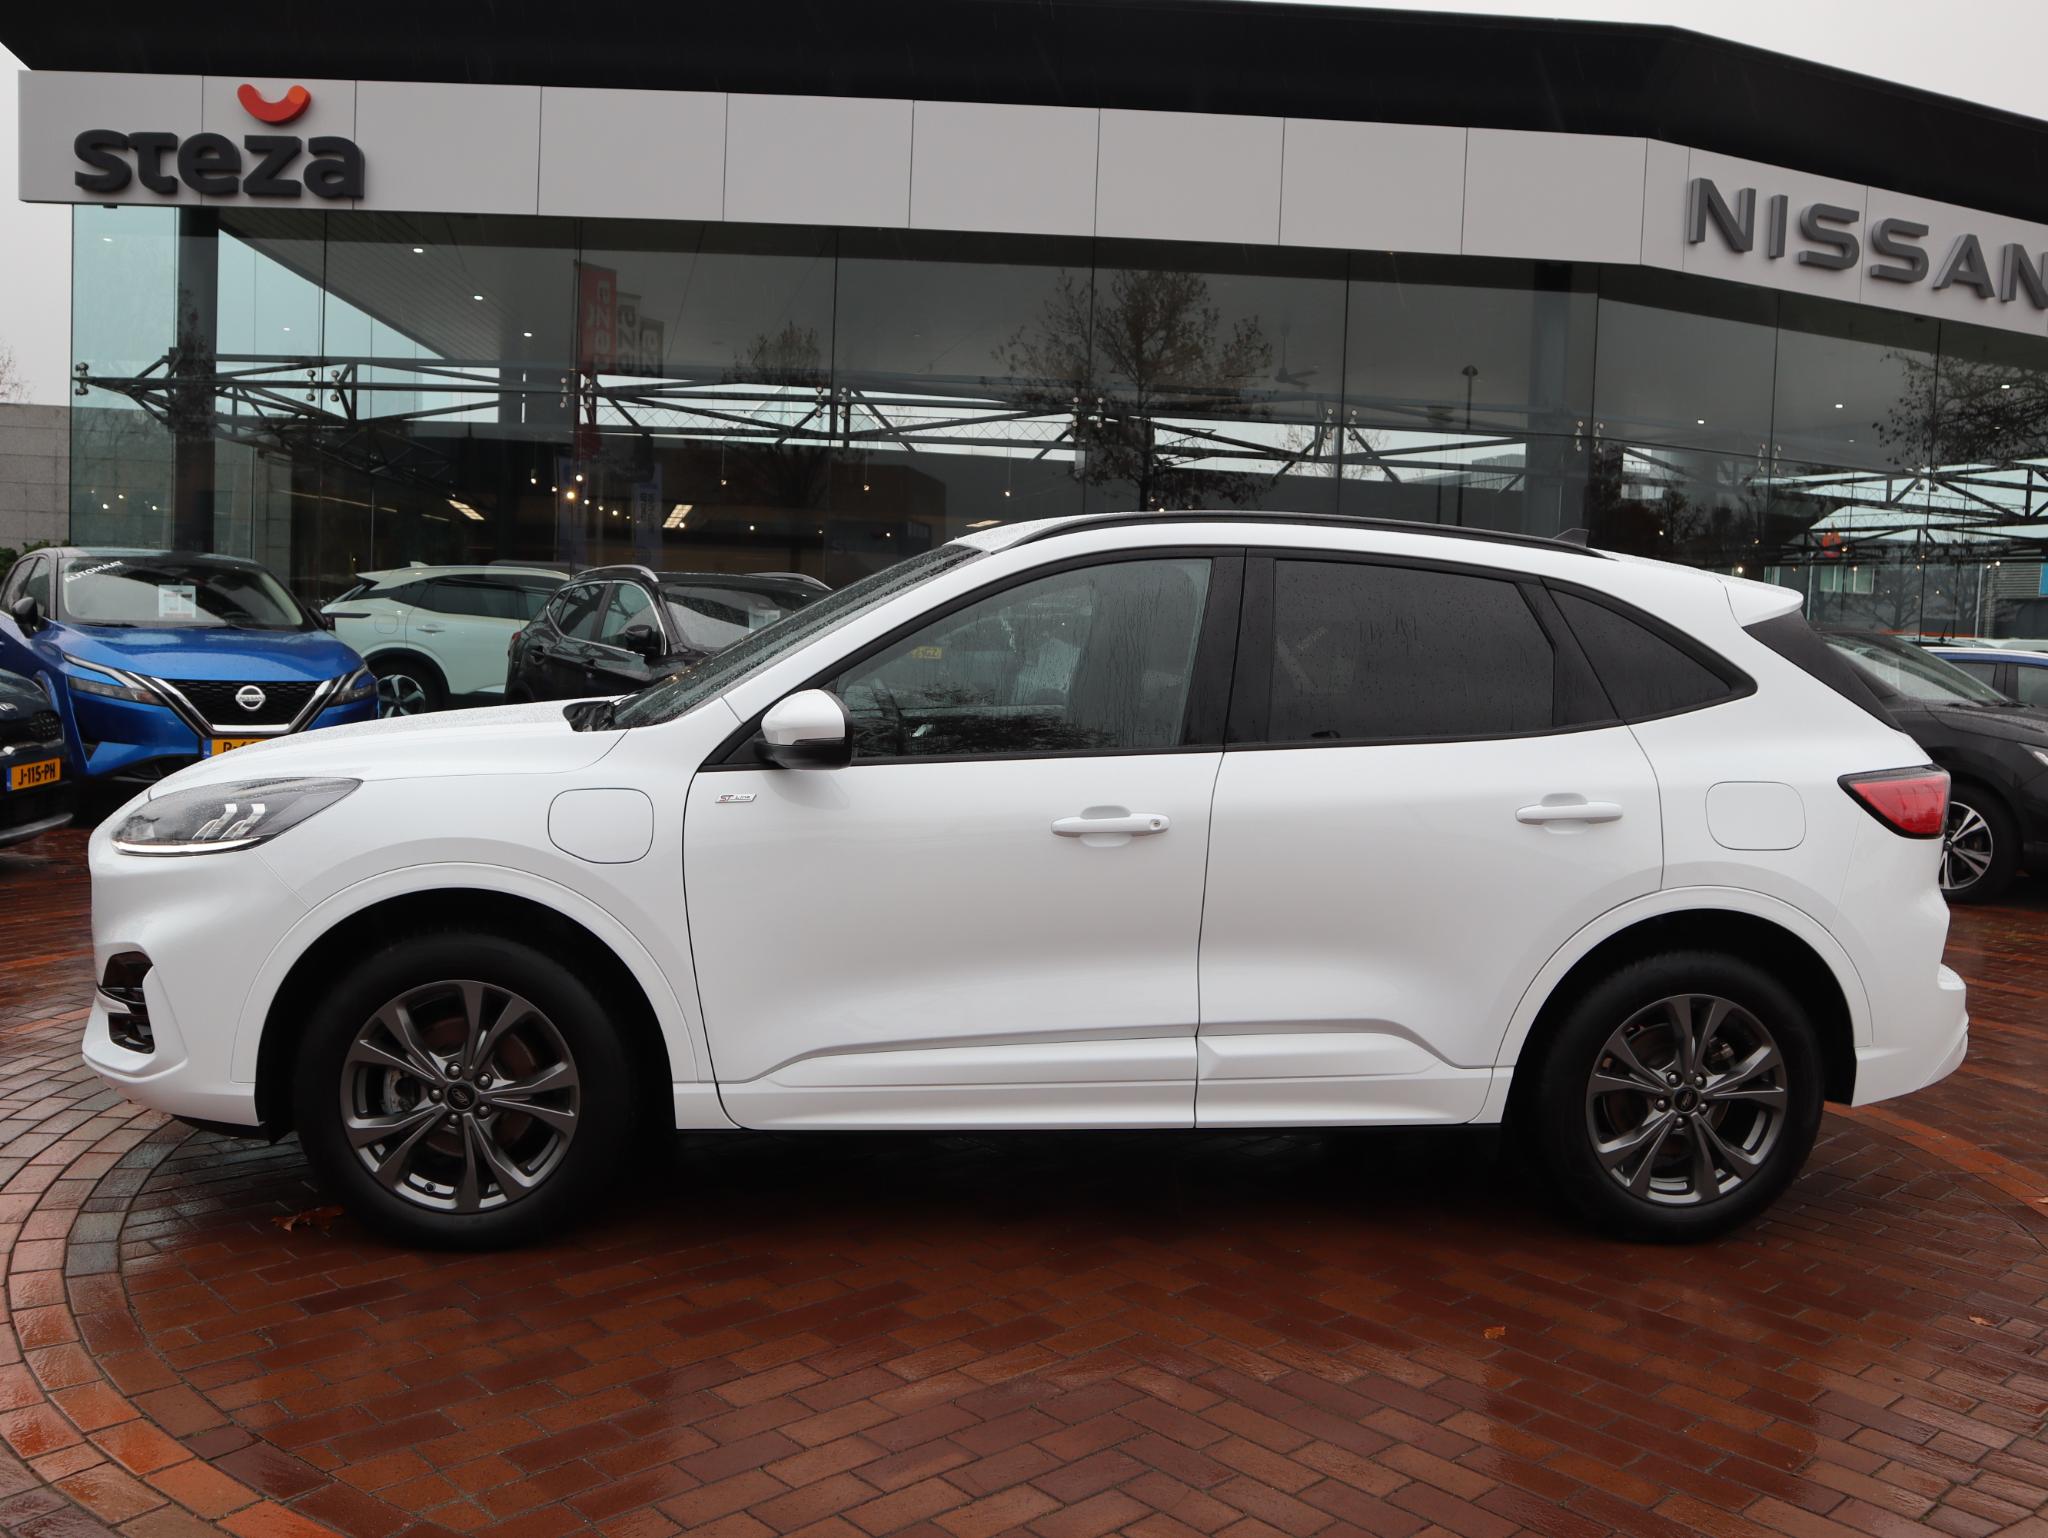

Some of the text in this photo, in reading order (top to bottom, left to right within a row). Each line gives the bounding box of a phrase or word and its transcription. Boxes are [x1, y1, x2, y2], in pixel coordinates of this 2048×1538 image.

[1689, 178, 2048, 311] NISSAN
[65, 560, 123, 582] AUTOMAAT
[18, 762, 56, 785] J-115-PH
